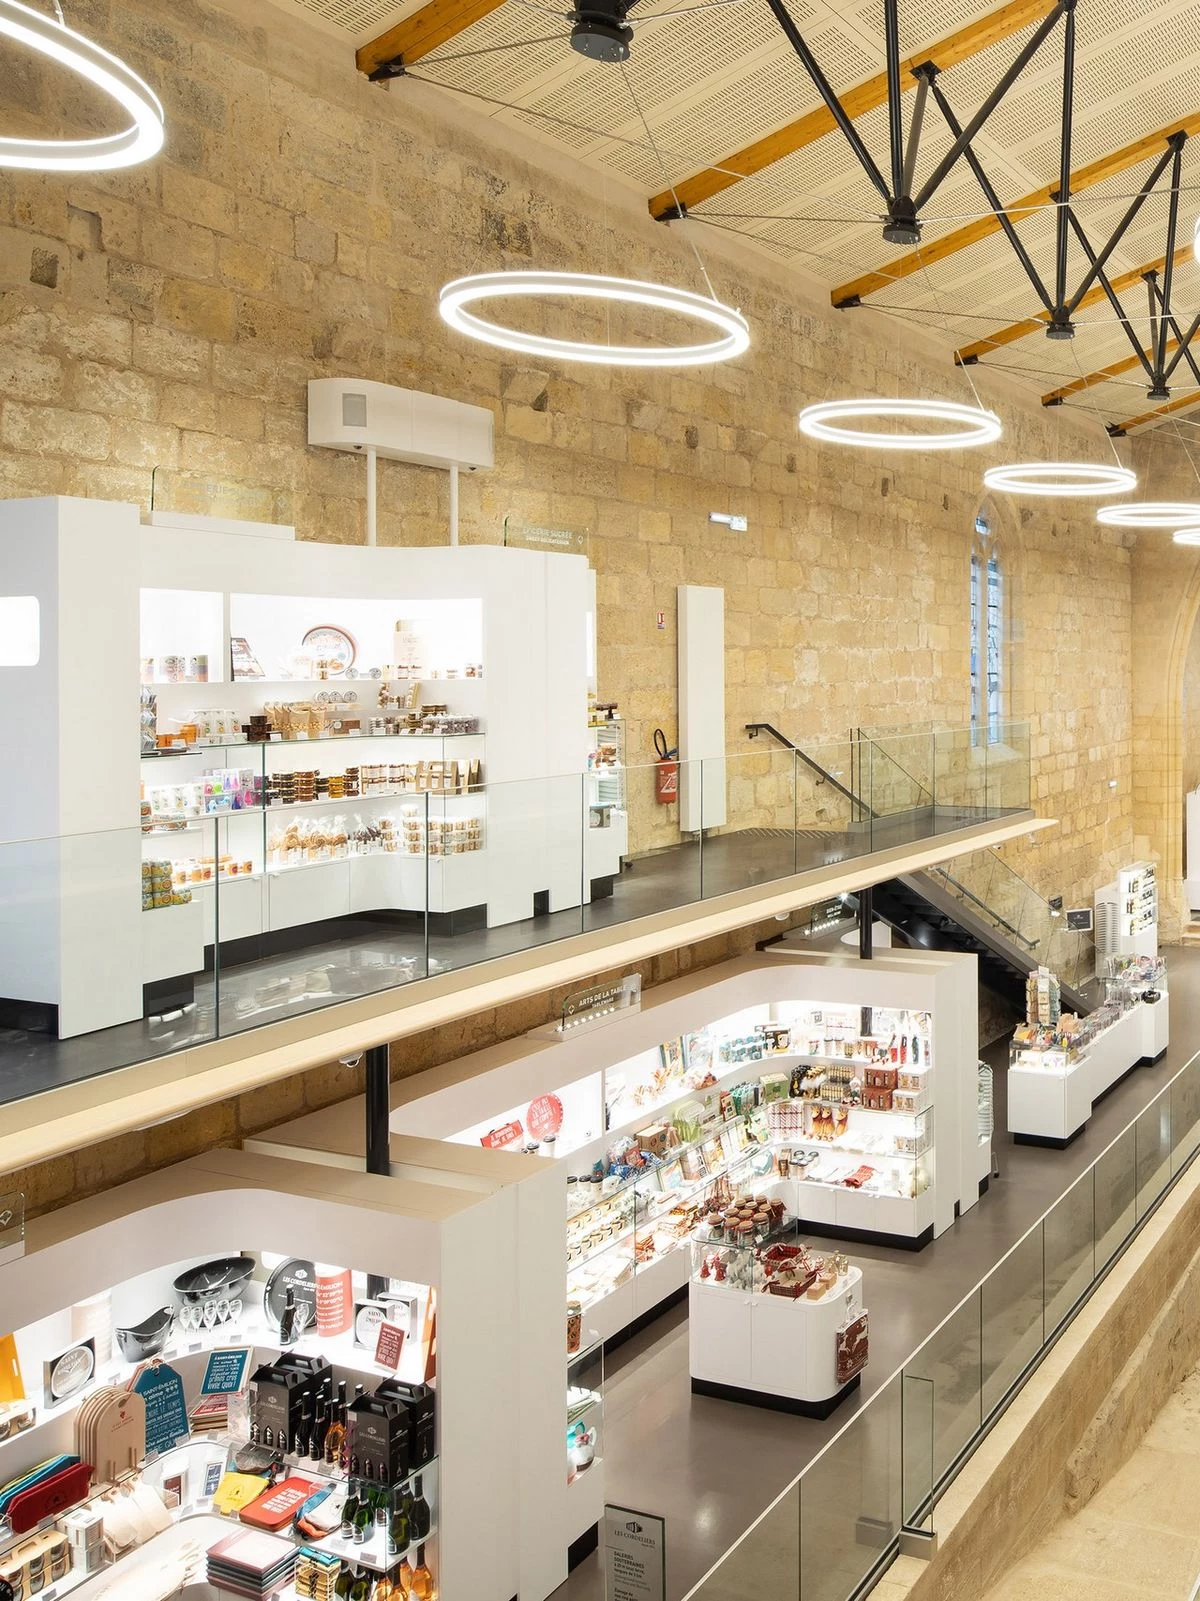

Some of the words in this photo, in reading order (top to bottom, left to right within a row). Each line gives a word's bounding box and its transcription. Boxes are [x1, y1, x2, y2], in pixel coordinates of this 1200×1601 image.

[579, 995, 594, 1007] ARTS
[594, 992, 602, 1001] DE
[602, 990, 610, 999] LA
[623, 1531, 656, 1545] CORDELIERS
